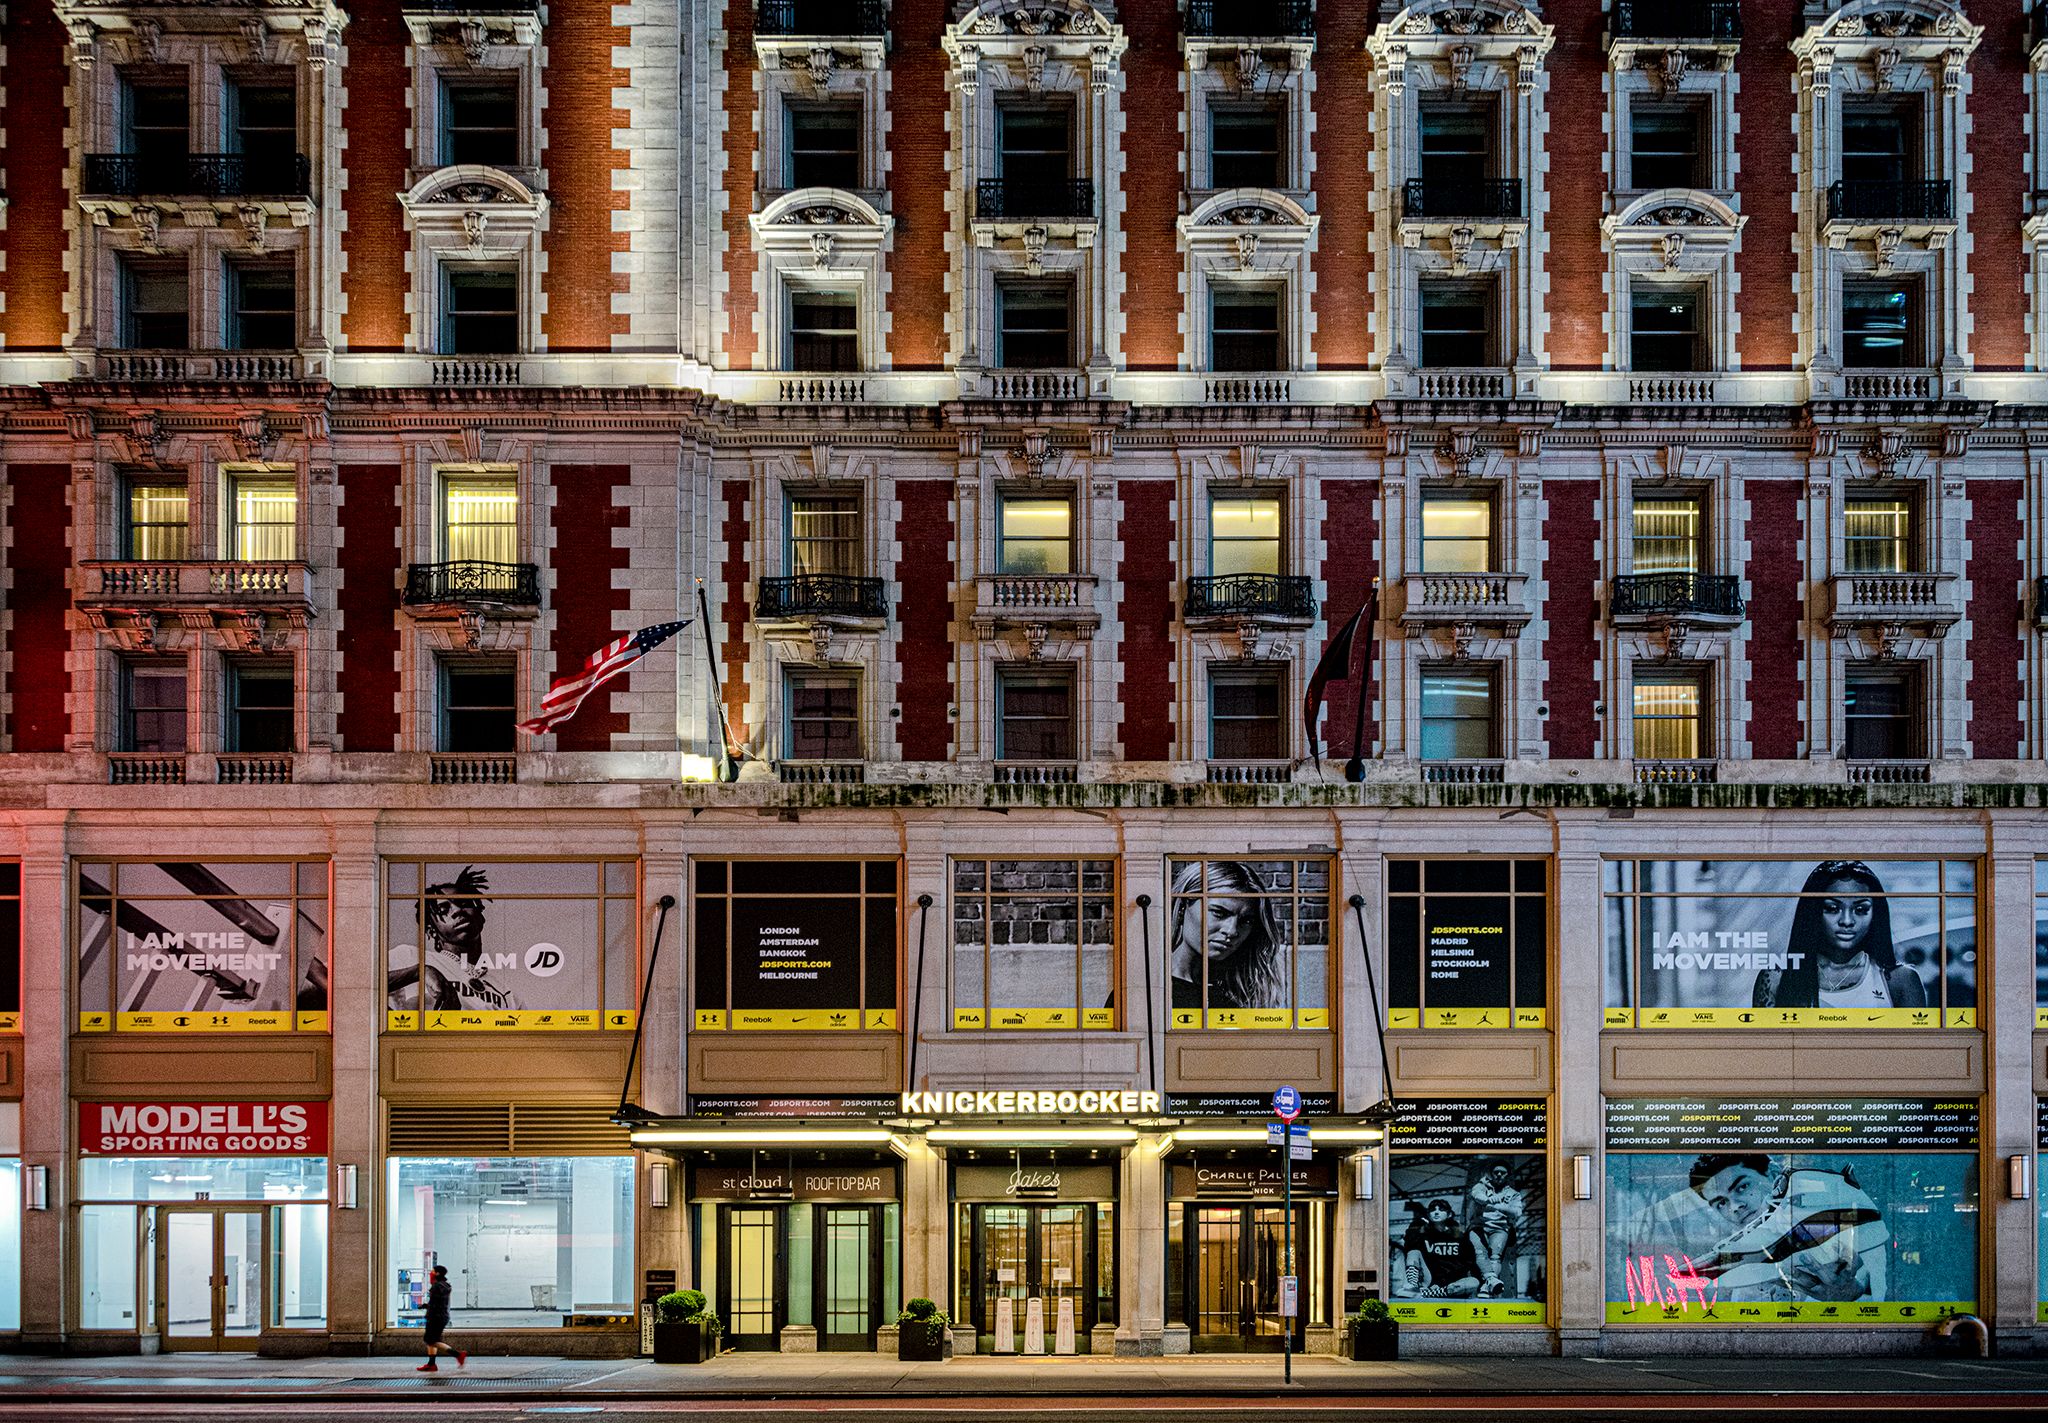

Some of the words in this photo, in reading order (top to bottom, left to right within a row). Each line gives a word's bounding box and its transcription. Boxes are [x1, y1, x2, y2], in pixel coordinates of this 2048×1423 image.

[126, 932, 136, 948] I
[140, 932, 184, 948] AM
[190, 932, 244, 948] THE
[1652, 932, 1660, 948] I
[1666, 932, 1709, 948] AM
[1714, 932, 1768, 948] THE
[126, 954, 282, 970] MOVEMENT
[460, 953, 467, 969] I
[474, 953, 516, 969] AM
[530, 952, 560, 968] JD
[1652, 953, 1806, 970] MOVEMENT
[902, 1091, 1160, 1113] KNICKERBOCKER
[100, 1105, 308, 1134] MODELL'S
[101, 1136, 219, 1150] SPORTING
[224, 1136, 308, 1150] GOODS
[722, 1177, 736, 1189] st
[740, 1176, 782, 1189] cloud
[1006, 1170, 1060, 1194] Jake's
[1197, 1169, 1254, 1181] CHARLIE
[1259, 1169, 1308, 1180] PALER
[1424, 1240, 1460, 1256] VANS
